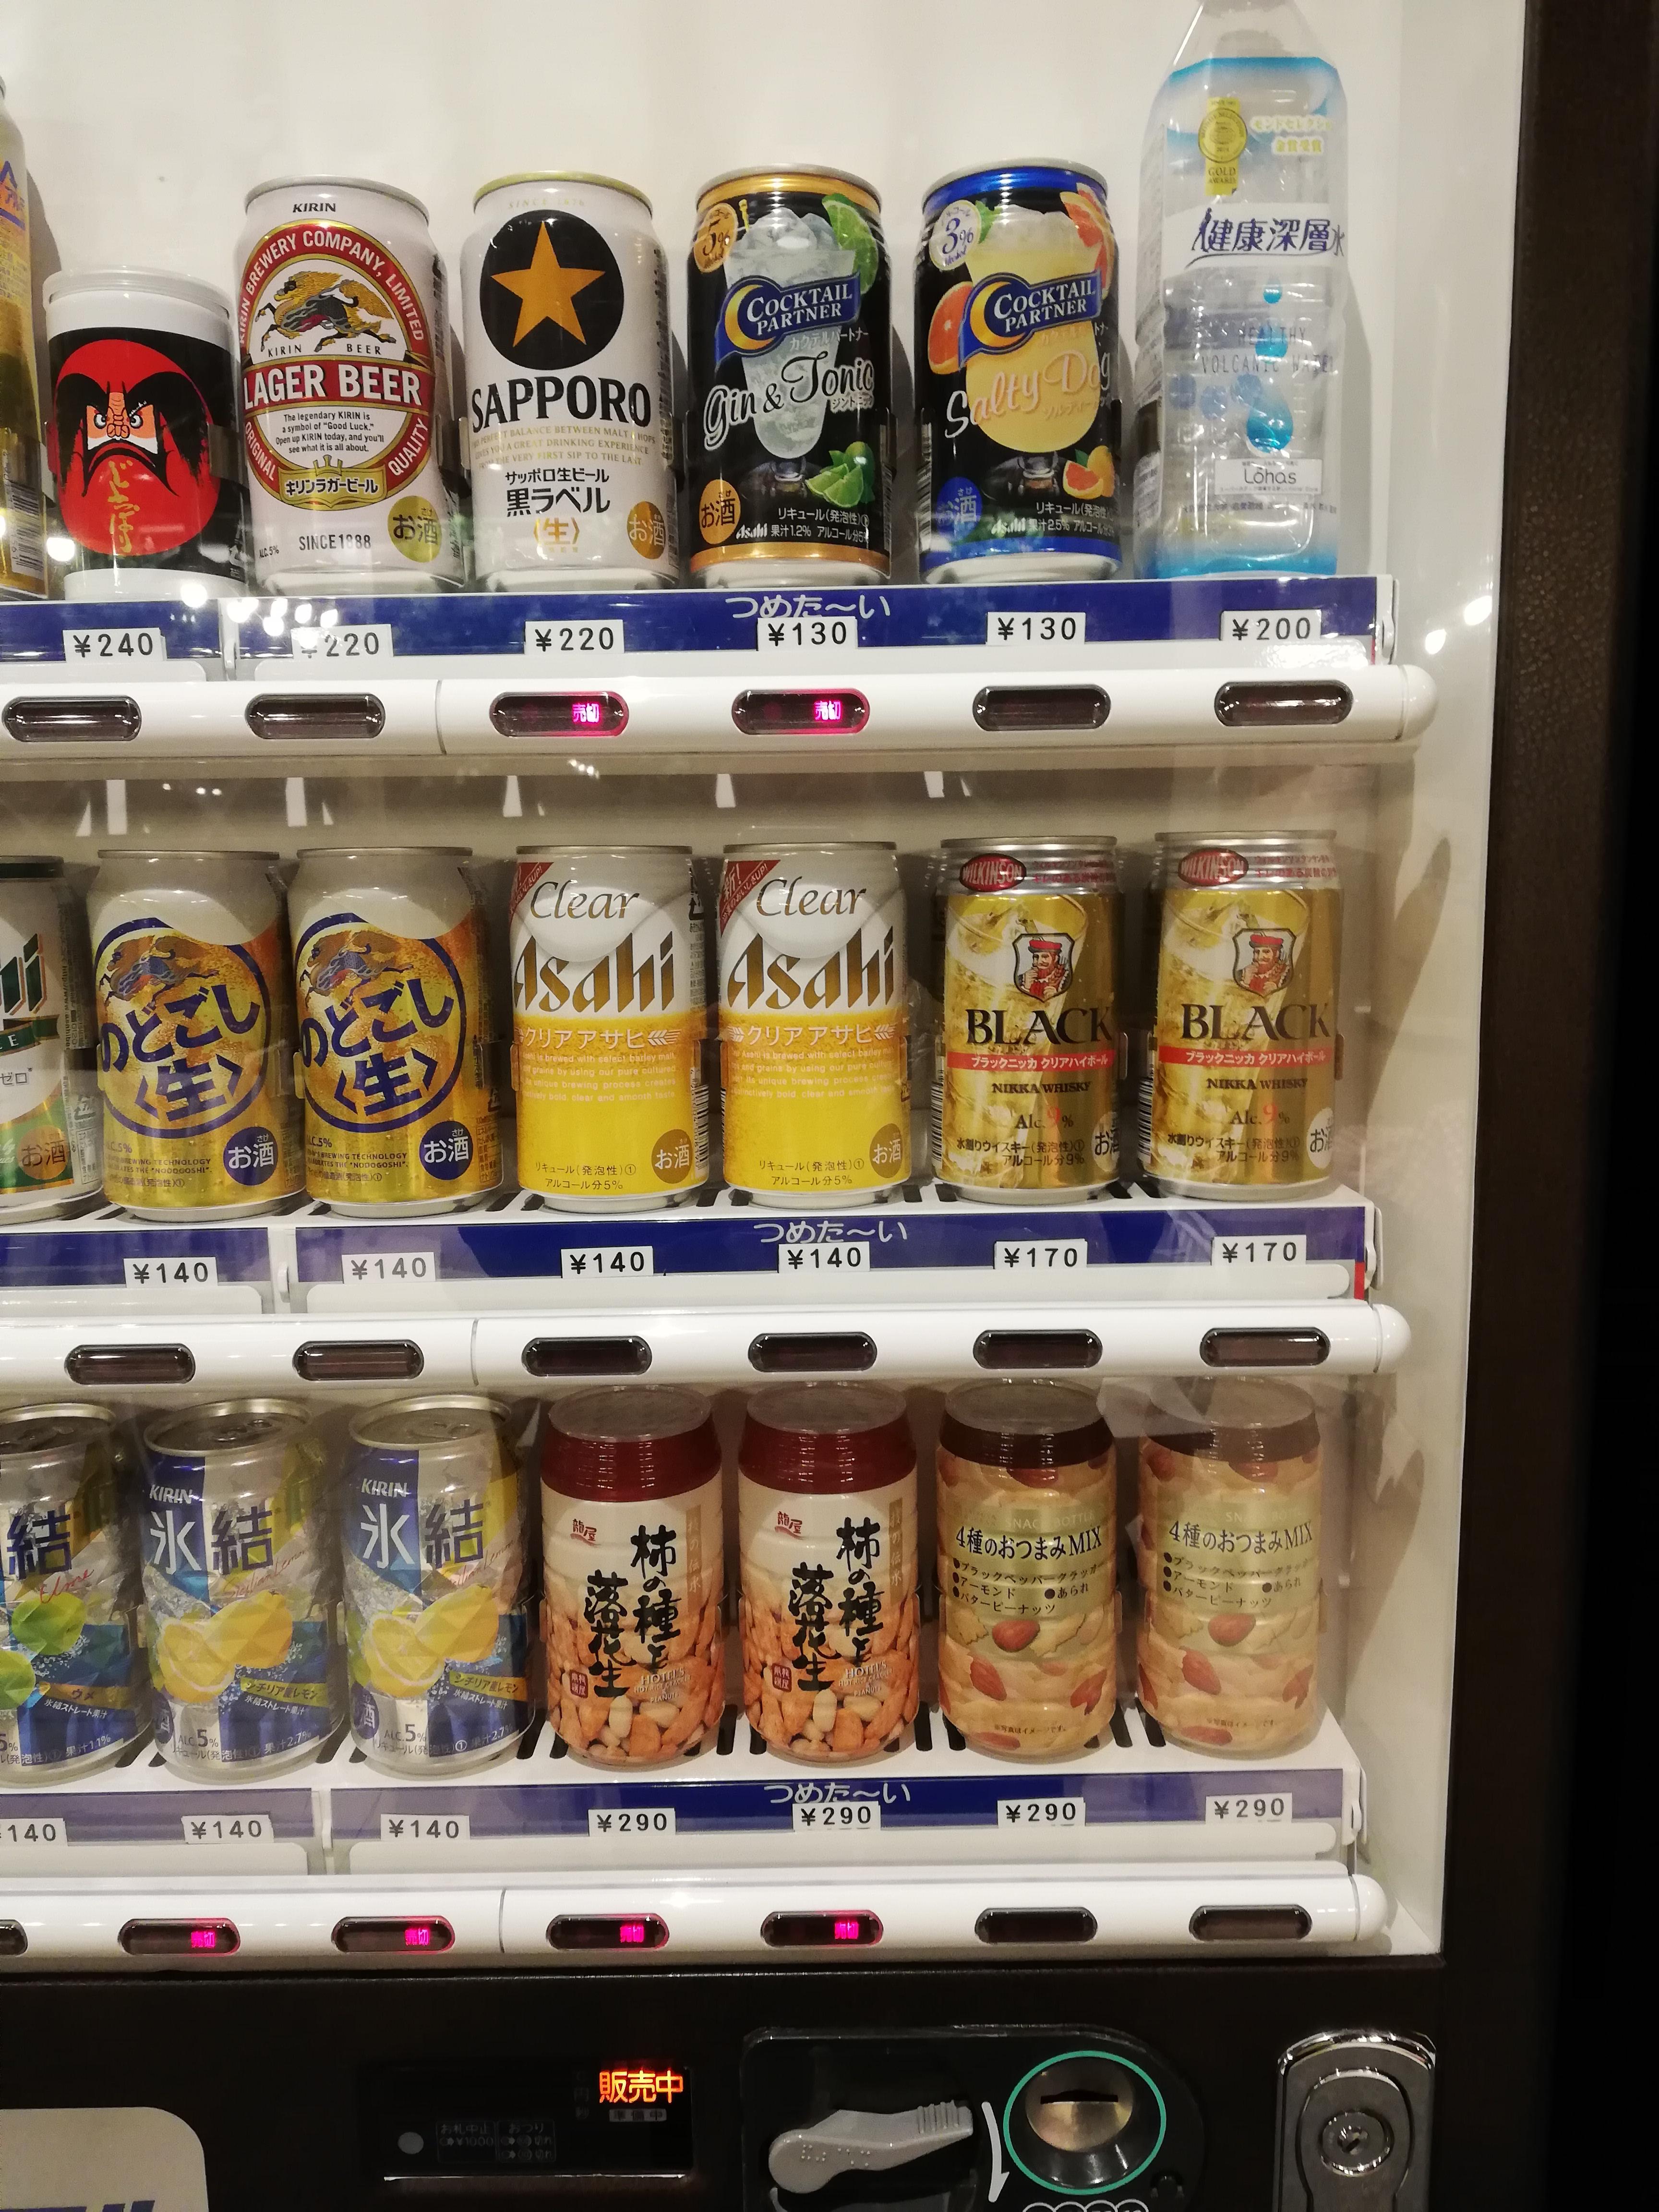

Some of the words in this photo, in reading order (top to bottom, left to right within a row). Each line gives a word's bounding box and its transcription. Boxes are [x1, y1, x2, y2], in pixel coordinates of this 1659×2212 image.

[1208, 167, 1236, 177] GOLD
[292, 203, 336, 213] KIRIN
[245, 233, 296, 295] BREWERY
[303, 230, 385, 277] COMPANY,
[385, 273, 424, 341] LIMITED
[746, 284, 853, 323] COCKTAIL
[994, 279, 1096, 320] COCKTAIL
[757, 302, 842, 337] PARTNER
[1006, 299, 1087, 333] PARTNER
[268, 344, 301, 357] KIRIN
[347, 344, 382, 355] BEER
[243, 364, 326, 410] LAGER
[338, 364, 422, 406] BEER
[704, 387, 757, 449] Gin
[763, 383, 784, 413] &
[781, 350, 874, 403] Tonic
[944, 369, 1042, 439] Salty
[1043, 349, 1111, 393] Dog
[472, 375, 651, 433] SAPPORO
[283, 414, 296, 422] The
[298, 412, 336, 421] legendary
[288, 423, 312, 433] symbol
[276, 437, 290, 446] Open
[292, 435, 300, 444] up
[301, 433, 322, 441] KIRIN
[325, 433, 347, 442] today,
[510, 426, 551, 437] BALANCE
[555, 425, 600, 436] BETWEEN
[604, 427, 628, 438] MALT
[244, 421, 276, 481] ORIGINAL
[388, 417, 429, 477] QUALITY
[512, 452, 533, 462] VERY
[537, 451, 563, 459] FIRST
[567, 451, 582, 459] SIP
[584, 451, 598, 460] TO
[601, 452, 619, 461] THE
[547, 438, 595, 447] DRINKING
[598, 440, 649, 455] EXPERIENCE
[286, 478, 378, 495] キリンラガービール
[505, 468, 609, 485] サッポロ生ビール
[506, 486, 611, 517] 黒ラベル
[701, 496, 735, 528] お酒
[393, 514, 438, 544] お酒
[628, 513, 665, 546] お酒
[735, 523, 768, 539] Asahi
[299, 534, 337, 551] SINCE
[535, 626, 614, 652] ¥220
[768, 621, 848, 647] ¥130
[997, 617, 1078, 641] ¥130
[1232, 617, 1312, 642] ¥200
[73, 633, 154, 658] ¥240
[962, 861, 1023, 885] WILKINSON
[530, 879, 640, 919] Clear
[756, 876, 866, 917] Clear
[514, 931, 674, 1013] Asahi
[727, 926, 894, 1010] Asahi
[102, 984, 261, 1074] のどごし
[301, 978, 455, 1069] のどごし
[965, 1008, 1113, 1045] BLACK
[1181, 1003, 1331, 1041] BLACK
[991, 1082, 1040, 1094] NIKKA
[1041, 1082, 1092, 1094] WHISKY
[1206, 1078, 1257, 1090] NIKKA
[1260, 1078, 1308, 1089] WHISKY
[21, 1139, 66, 1168] お酒
[228, 1140, 275, 1169] お酒
[424, 1136, 469, 1164] お酒
[654, 1143, 690, 1170] お酒
[872, 1138, 902, 1165] お酒
[544, 1178, 624, 1190] アルコール分5%
[771, 1175, 853, 1186] アルコール分5%
[570, 1251, 645, 1274] ¥140
[787, 1246, 862, 1270] ¥140
[1004, 1247, 1078, 1268] ¥170
[1222, 1241, 1298, 1263] ¥170
[132, 1262, 208, 1284] ¥140
[350, 1257, 427, 1281] ¥140
[149, 1484, 193, 1504] KIRIN
[361, 1478, 408, 1498] KIRIN
[150, 1505, 274, 1575] 氷結
[360, 1498, 484, 1570] 氷結
[956, 1525, 1103, 1561] 4種のおつまみMIX
[1169, 1518, 1314, 1554] 4種のおつまみMIX
[961, 1577, 1015, 1599] アーモンド
[961, 1592, 1056, 1614] バターピーナッツ
[583, 1569, 637, 1698] 落花生
[788, 1562, 842, 1692] 落花生
[800, 1805, 872, 1826] ¥290
[1006, 1803, 1076, 1822] ¥290
[1213, 1798, 1286, 1818] ¥290
[0, 1824, 57, 1842] 140
[192, 1820, 262, 1839] ¥140
[388, 1819, 460, 1839] ¥140
[597, 1813, 667, 1832] ¥290
[599, 2069, 684, 2104] 販売中
